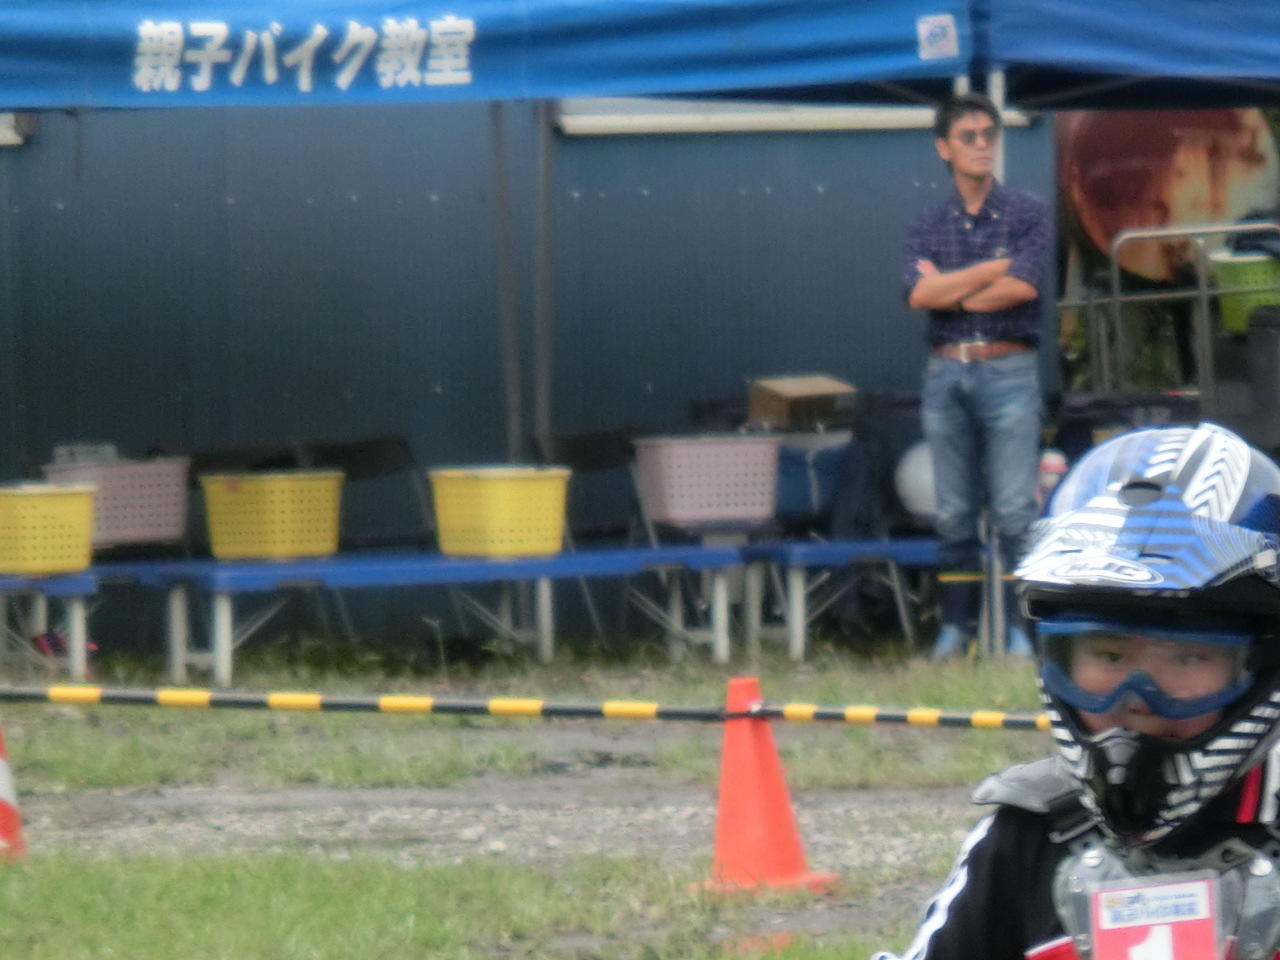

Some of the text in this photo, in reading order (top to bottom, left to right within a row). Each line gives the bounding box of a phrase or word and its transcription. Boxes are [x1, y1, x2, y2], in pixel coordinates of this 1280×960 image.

[133, 16, 475, 92] 親子バイク教室
